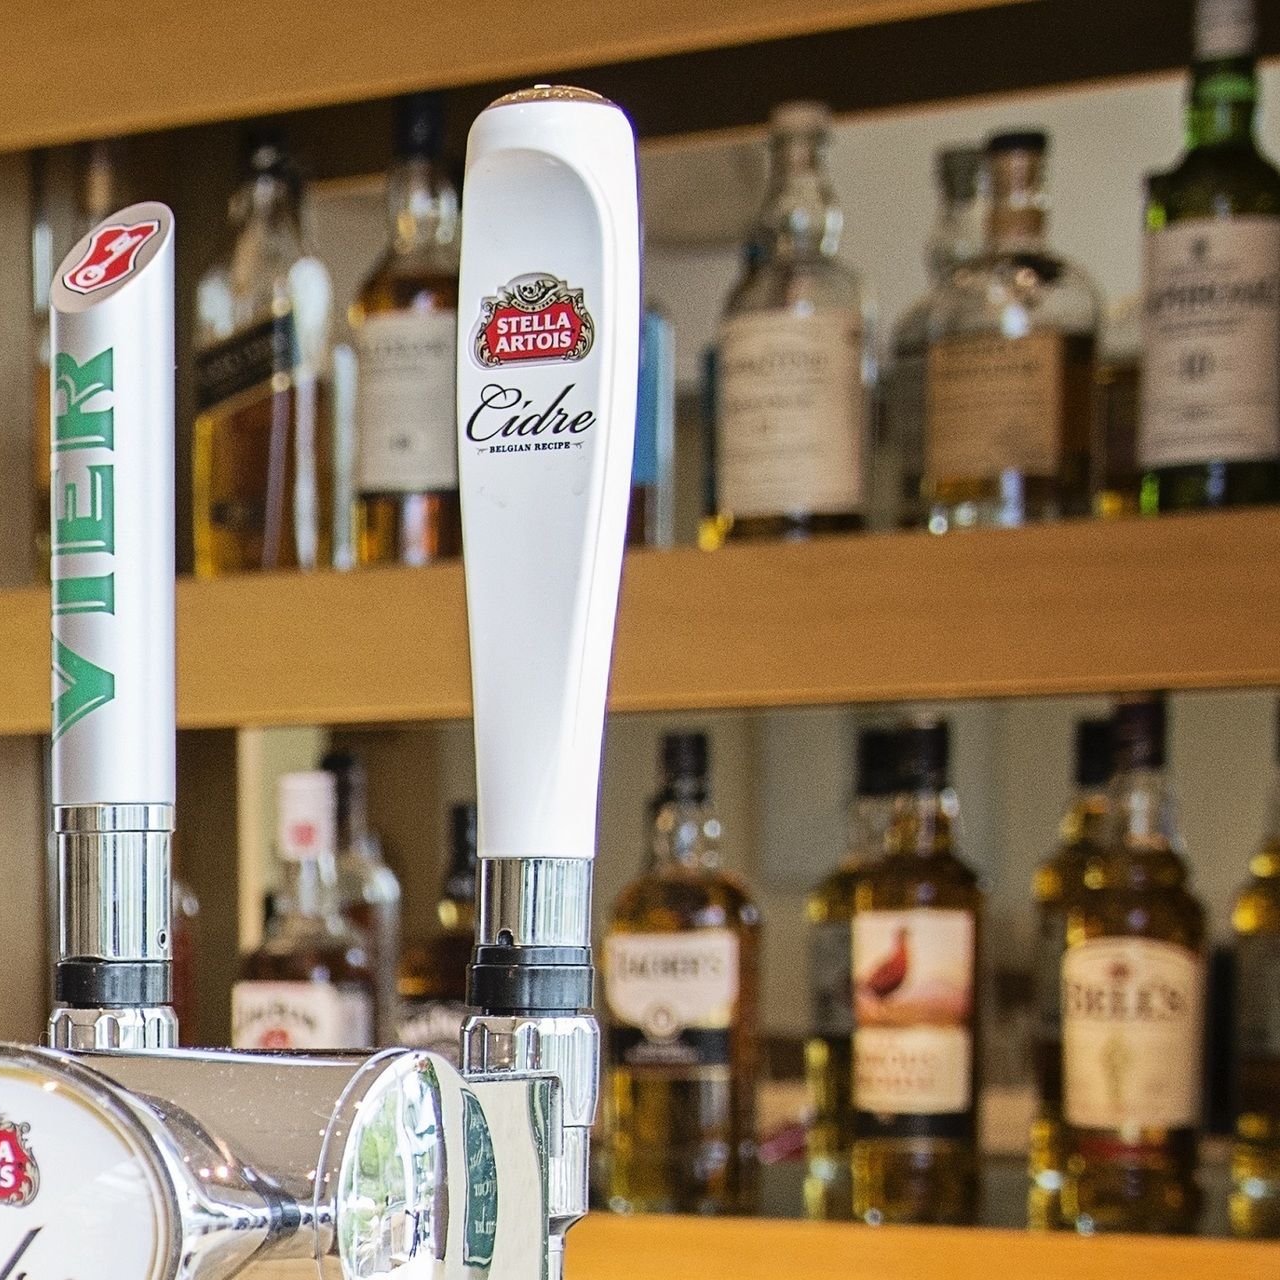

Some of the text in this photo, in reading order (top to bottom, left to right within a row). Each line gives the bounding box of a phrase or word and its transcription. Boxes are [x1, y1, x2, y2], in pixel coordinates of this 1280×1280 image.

[496, 312, 571, 334] STELLA
[496, 331, 571, 353] ARTOIS
[466, 383, 596, 441] Cidre
[490, 441, 571, 453] BELGIAN RECIPE
[50, 347, 115, 748] VIER
